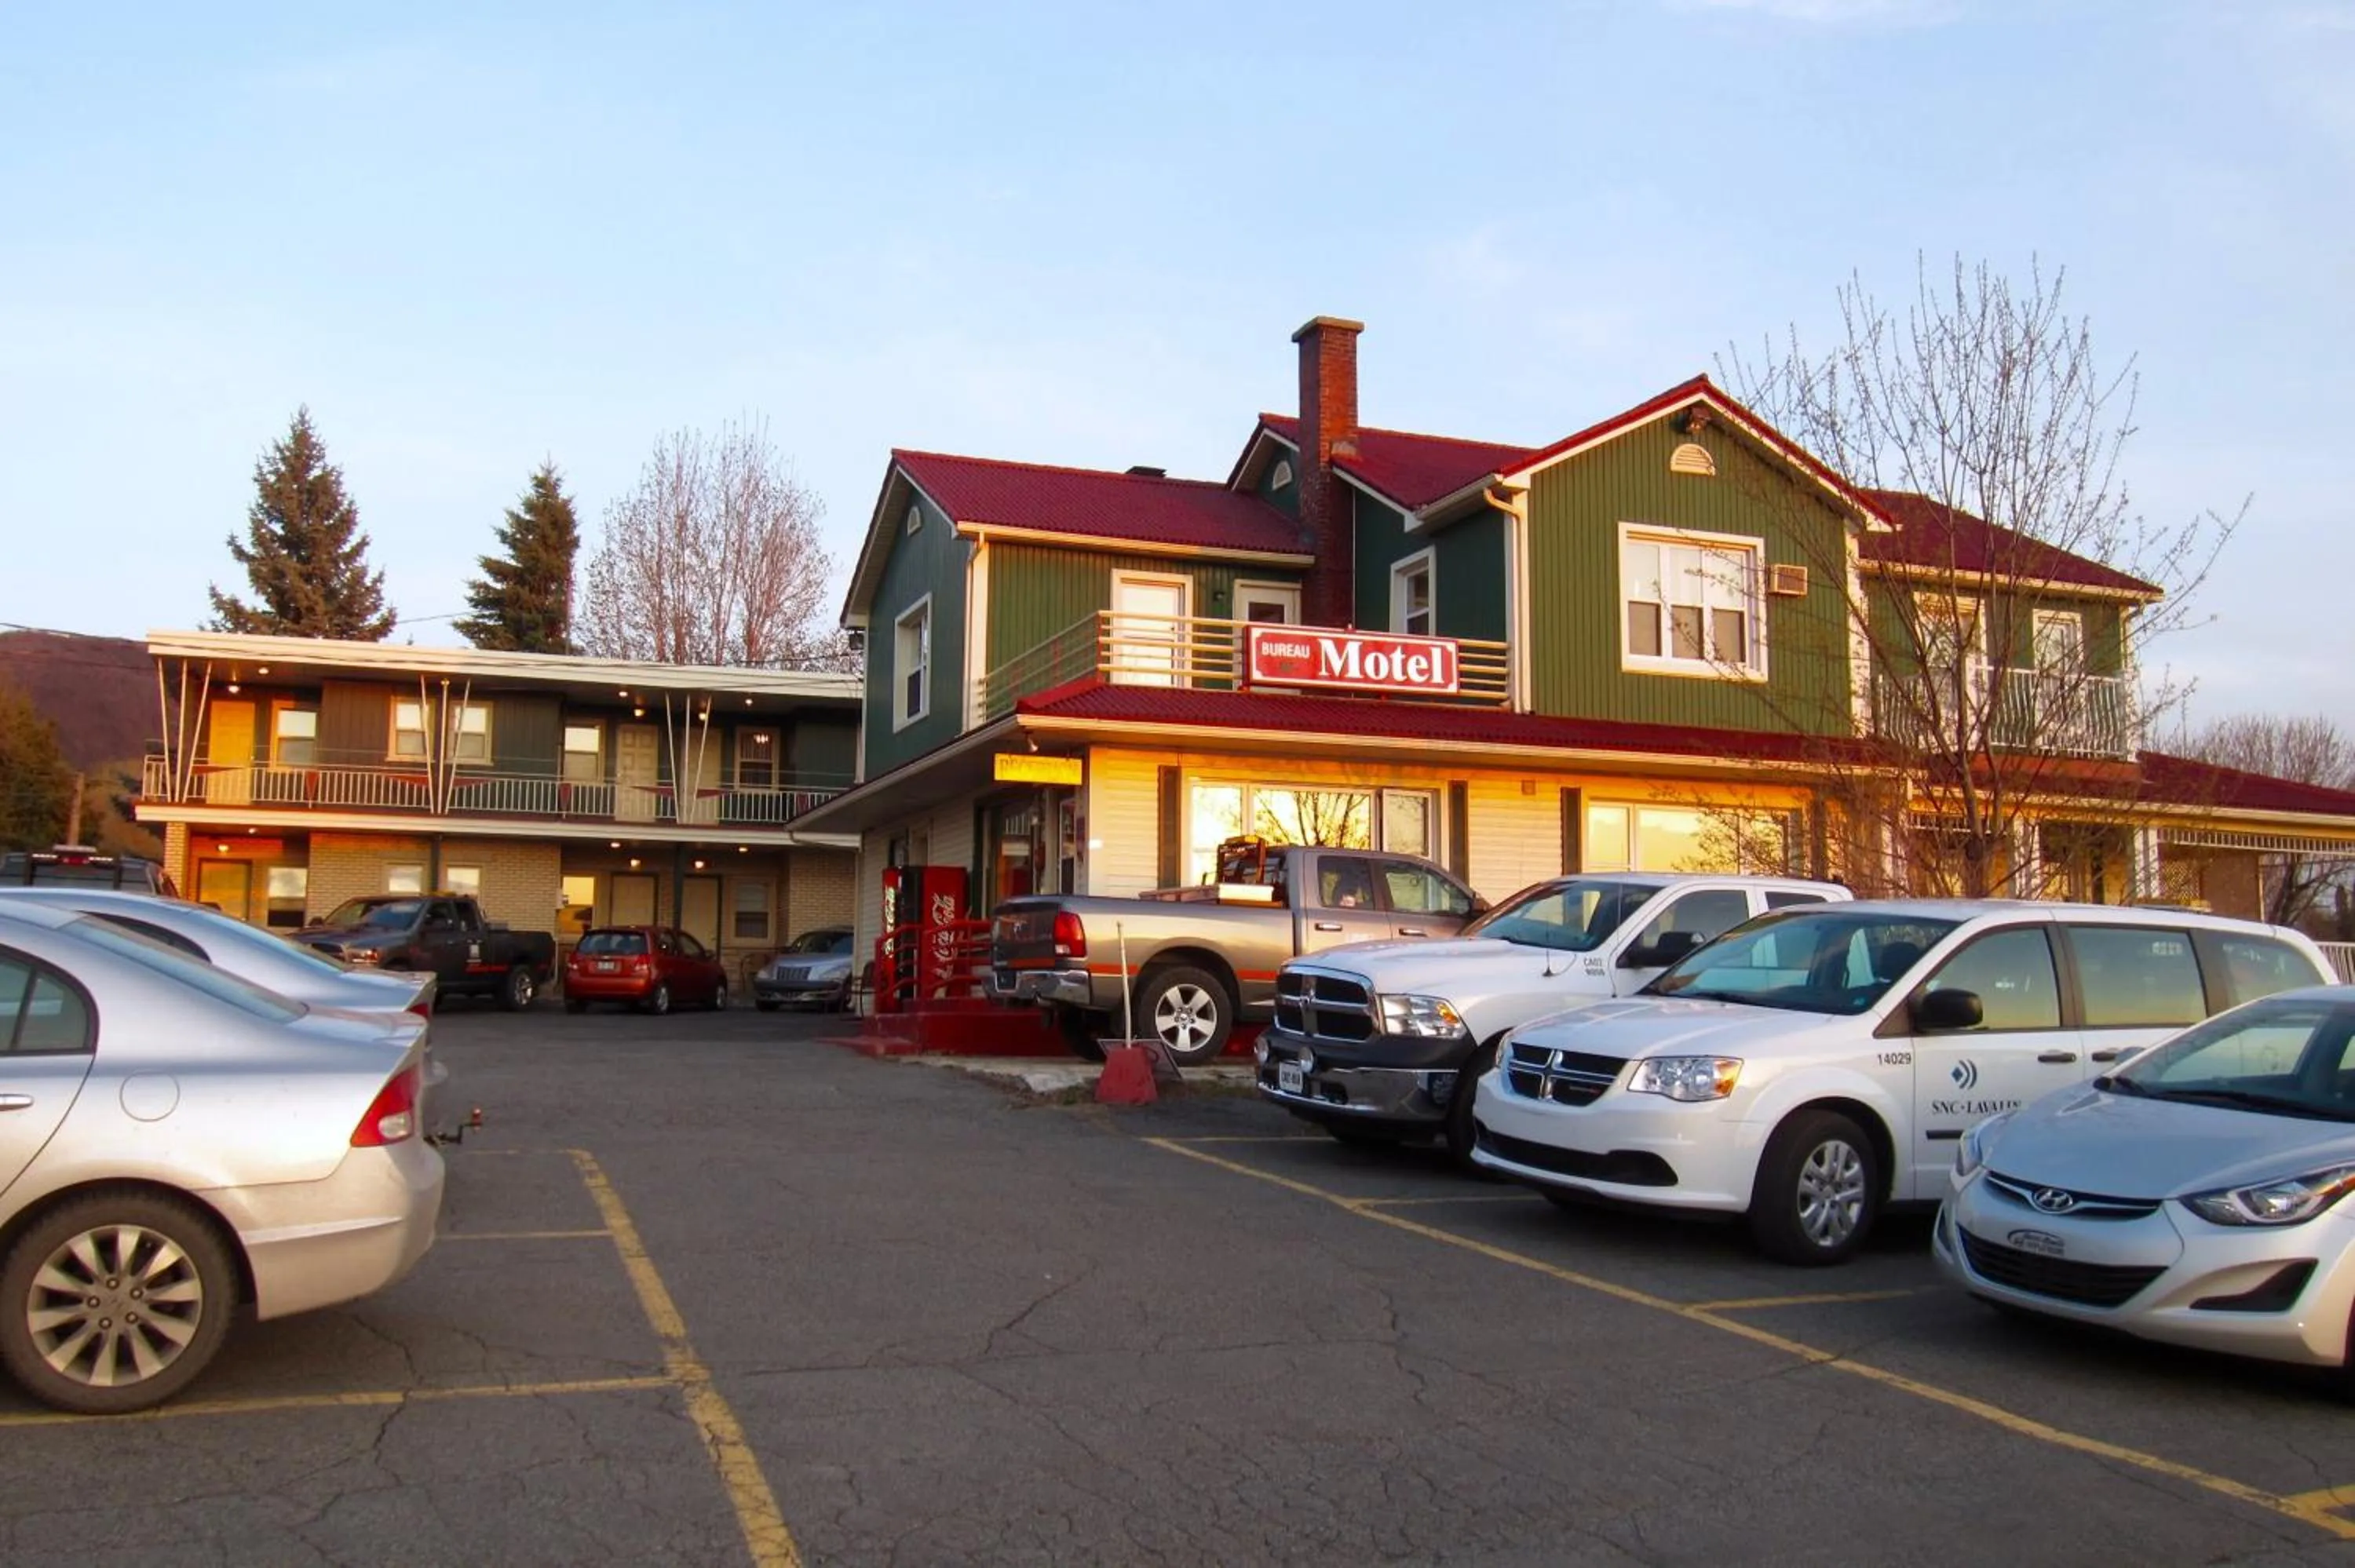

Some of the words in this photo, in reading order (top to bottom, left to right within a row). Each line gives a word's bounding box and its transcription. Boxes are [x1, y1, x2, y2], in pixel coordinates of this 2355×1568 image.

[1261, 641, 1310, 658] BUREAU
[1318, 638, 1445, 684] Motel
[1877, 1052, 1911, 1067] 14029
